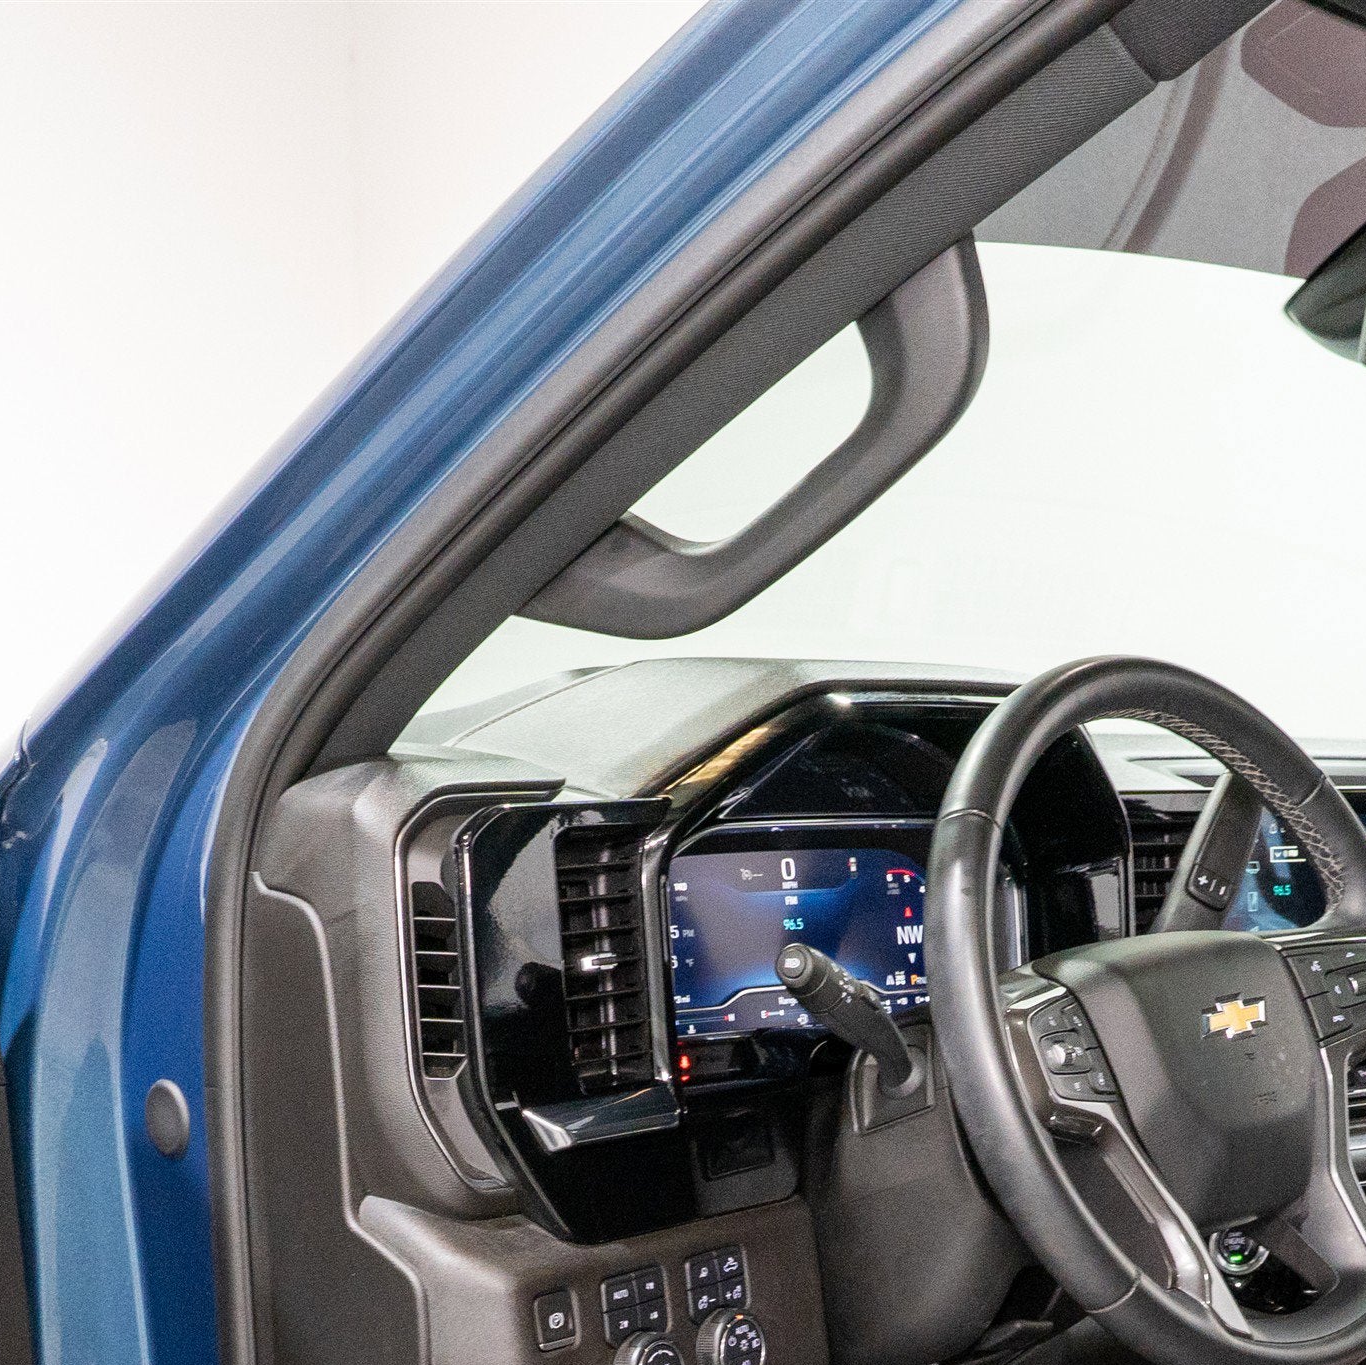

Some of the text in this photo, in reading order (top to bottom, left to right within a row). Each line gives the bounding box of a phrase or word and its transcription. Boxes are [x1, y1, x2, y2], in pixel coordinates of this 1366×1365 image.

[780, 857, 796, 880] 0
[782, 917, 805, 930] 96.5
[896, 924, 924, 945] NW
